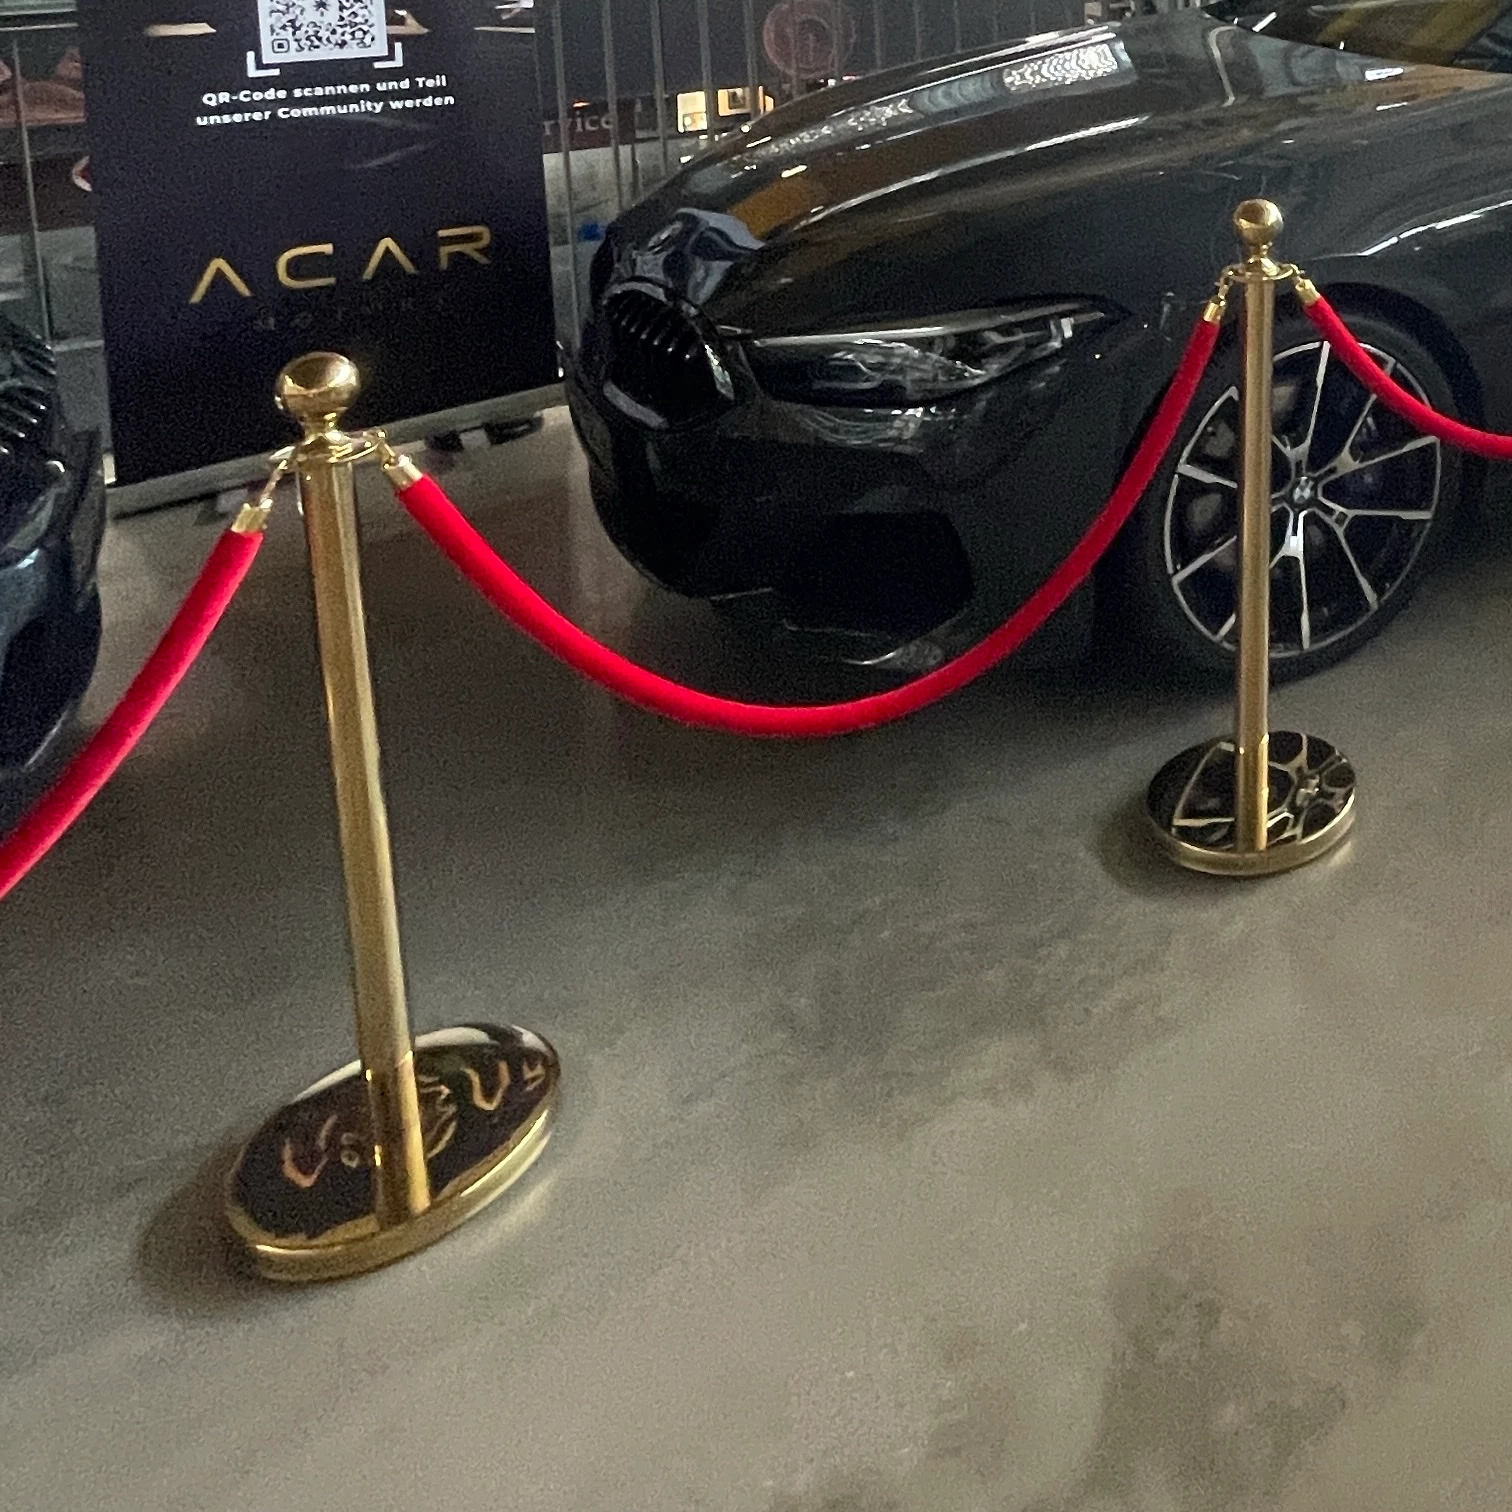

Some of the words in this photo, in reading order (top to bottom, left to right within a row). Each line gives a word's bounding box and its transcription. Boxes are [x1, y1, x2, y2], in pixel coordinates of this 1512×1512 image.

[201, 88, 287, 107] QR-Code
[292, 82, 370, 98] scannen
[376, 77, 409, 90] und
[415, 74, 447, 88] Teil
[196, 110, 271, 127] unserer
[276, 99, 384, 120] Community
[389, 94, 455, 110] werden
[188, 224, 493, 305] ACAR
